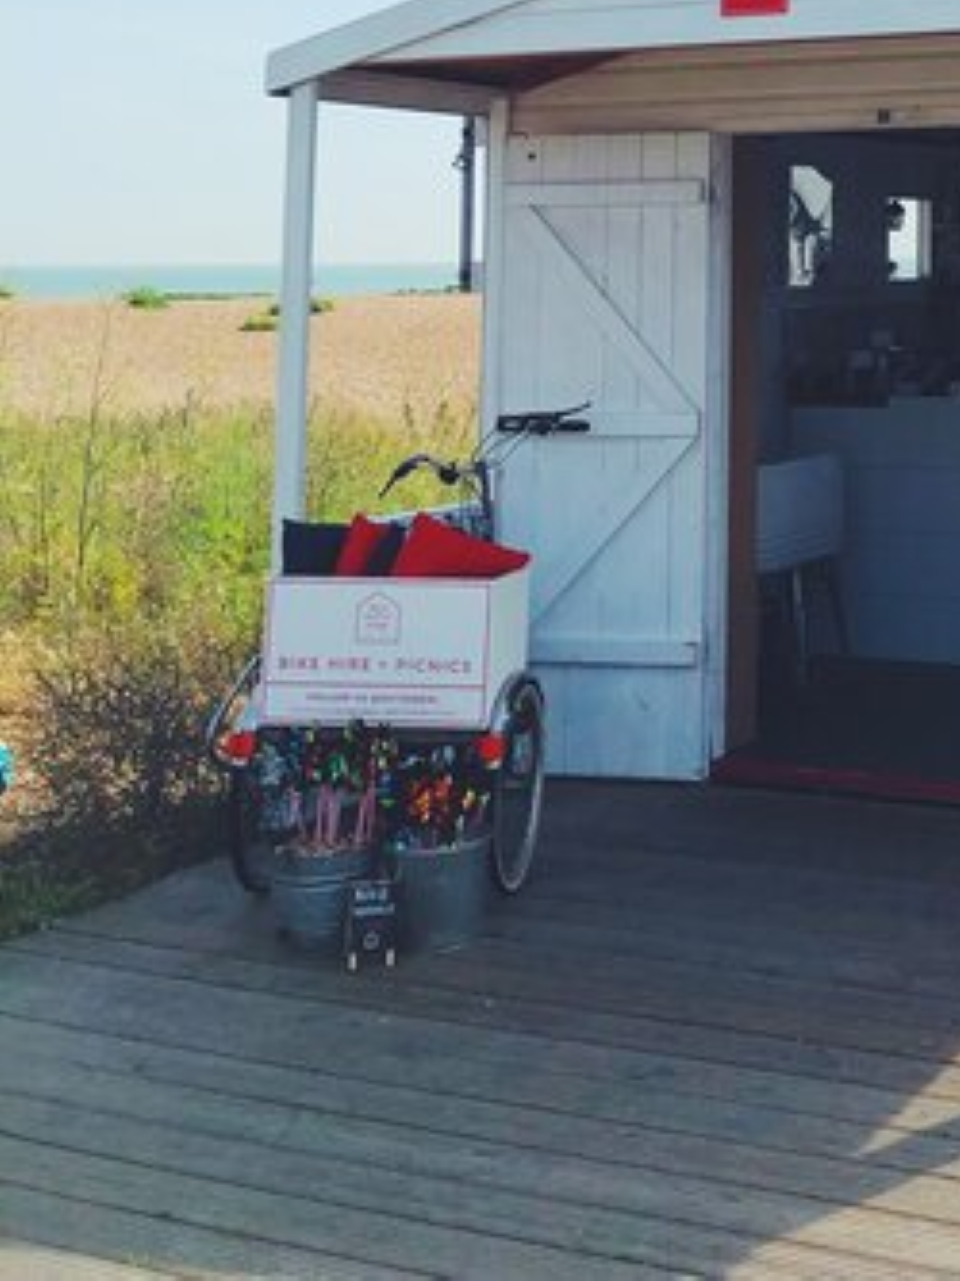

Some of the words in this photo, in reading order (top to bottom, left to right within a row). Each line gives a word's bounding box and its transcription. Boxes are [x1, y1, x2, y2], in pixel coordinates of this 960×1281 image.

[278, 656, 318, 670] BIKE
[327, 656, 369, 671] HIRE
[396, 657, 472, 674] PICNICS
